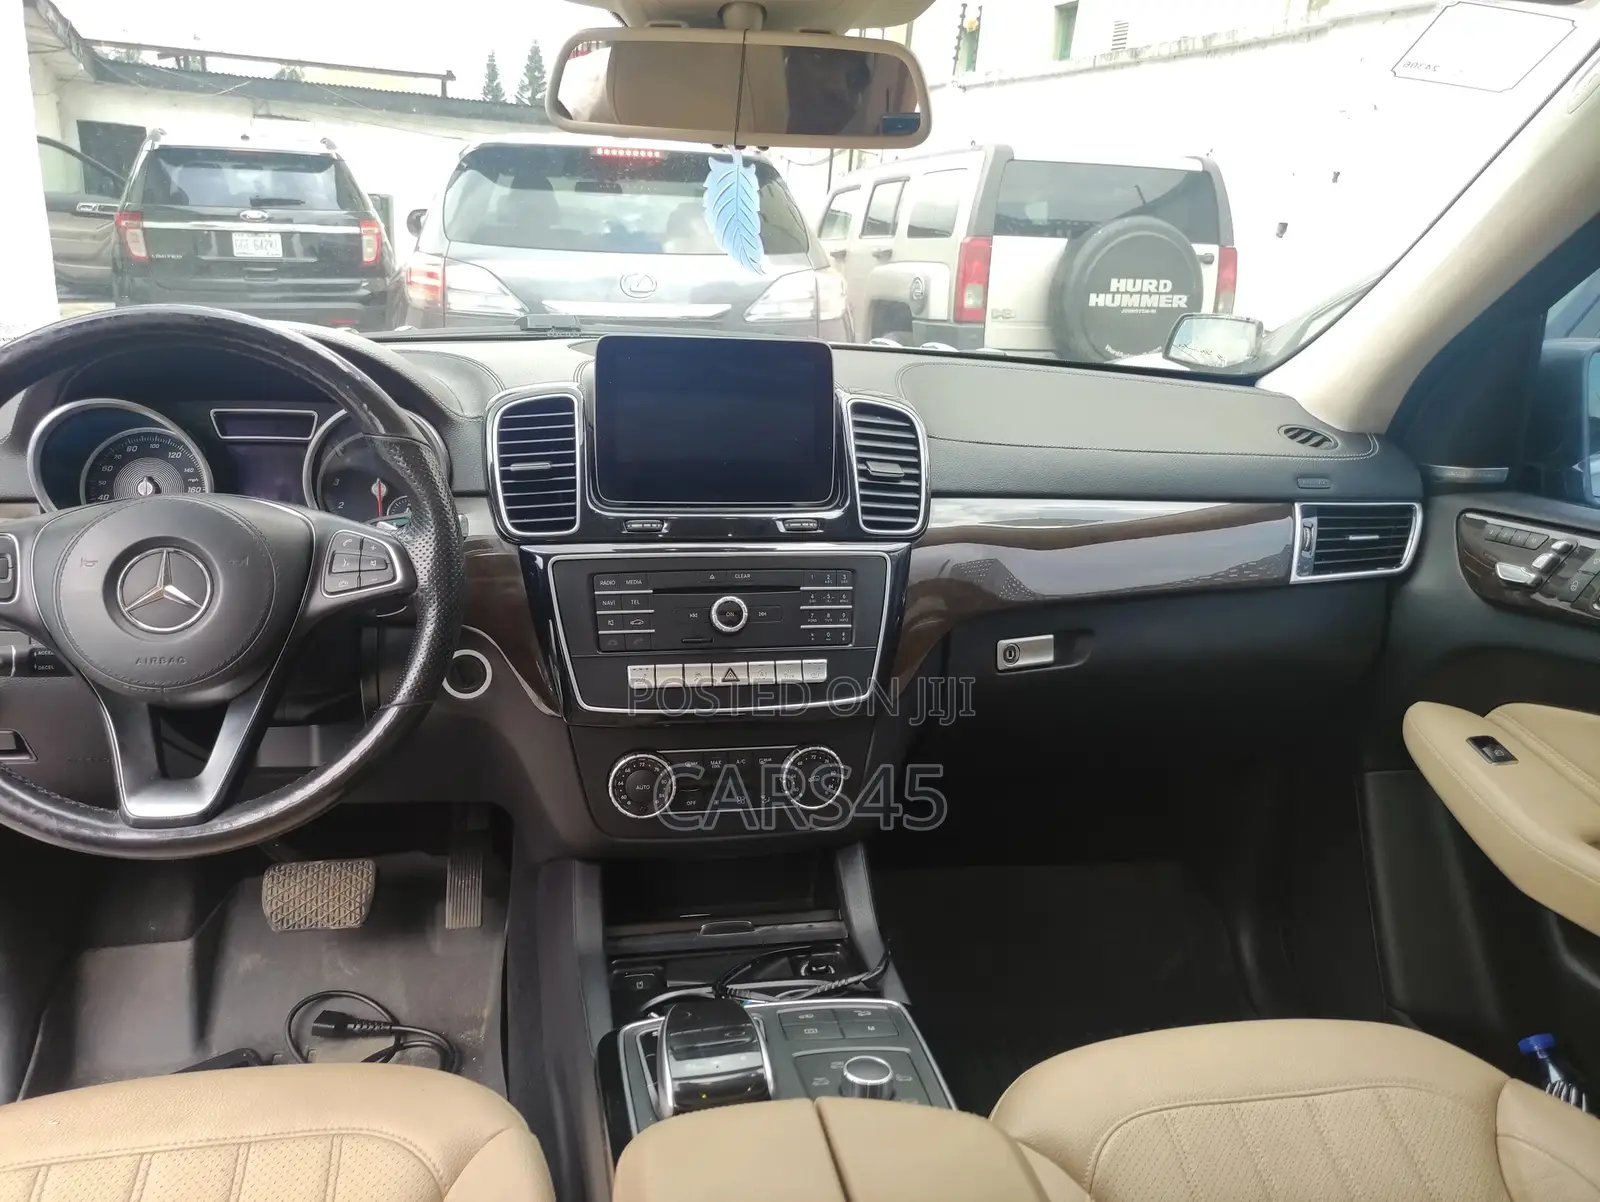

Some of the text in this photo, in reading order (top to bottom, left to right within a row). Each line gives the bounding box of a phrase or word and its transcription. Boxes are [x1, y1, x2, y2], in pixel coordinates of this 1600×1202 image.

[1110, 278, 1172, 293] HURD
[1089, 293, 1188, 308] HUMMER
[187, 486, 201, 494] 160
[337, 501, 345, 509] 2
[135, 657, 188, 666] AIRBAG
